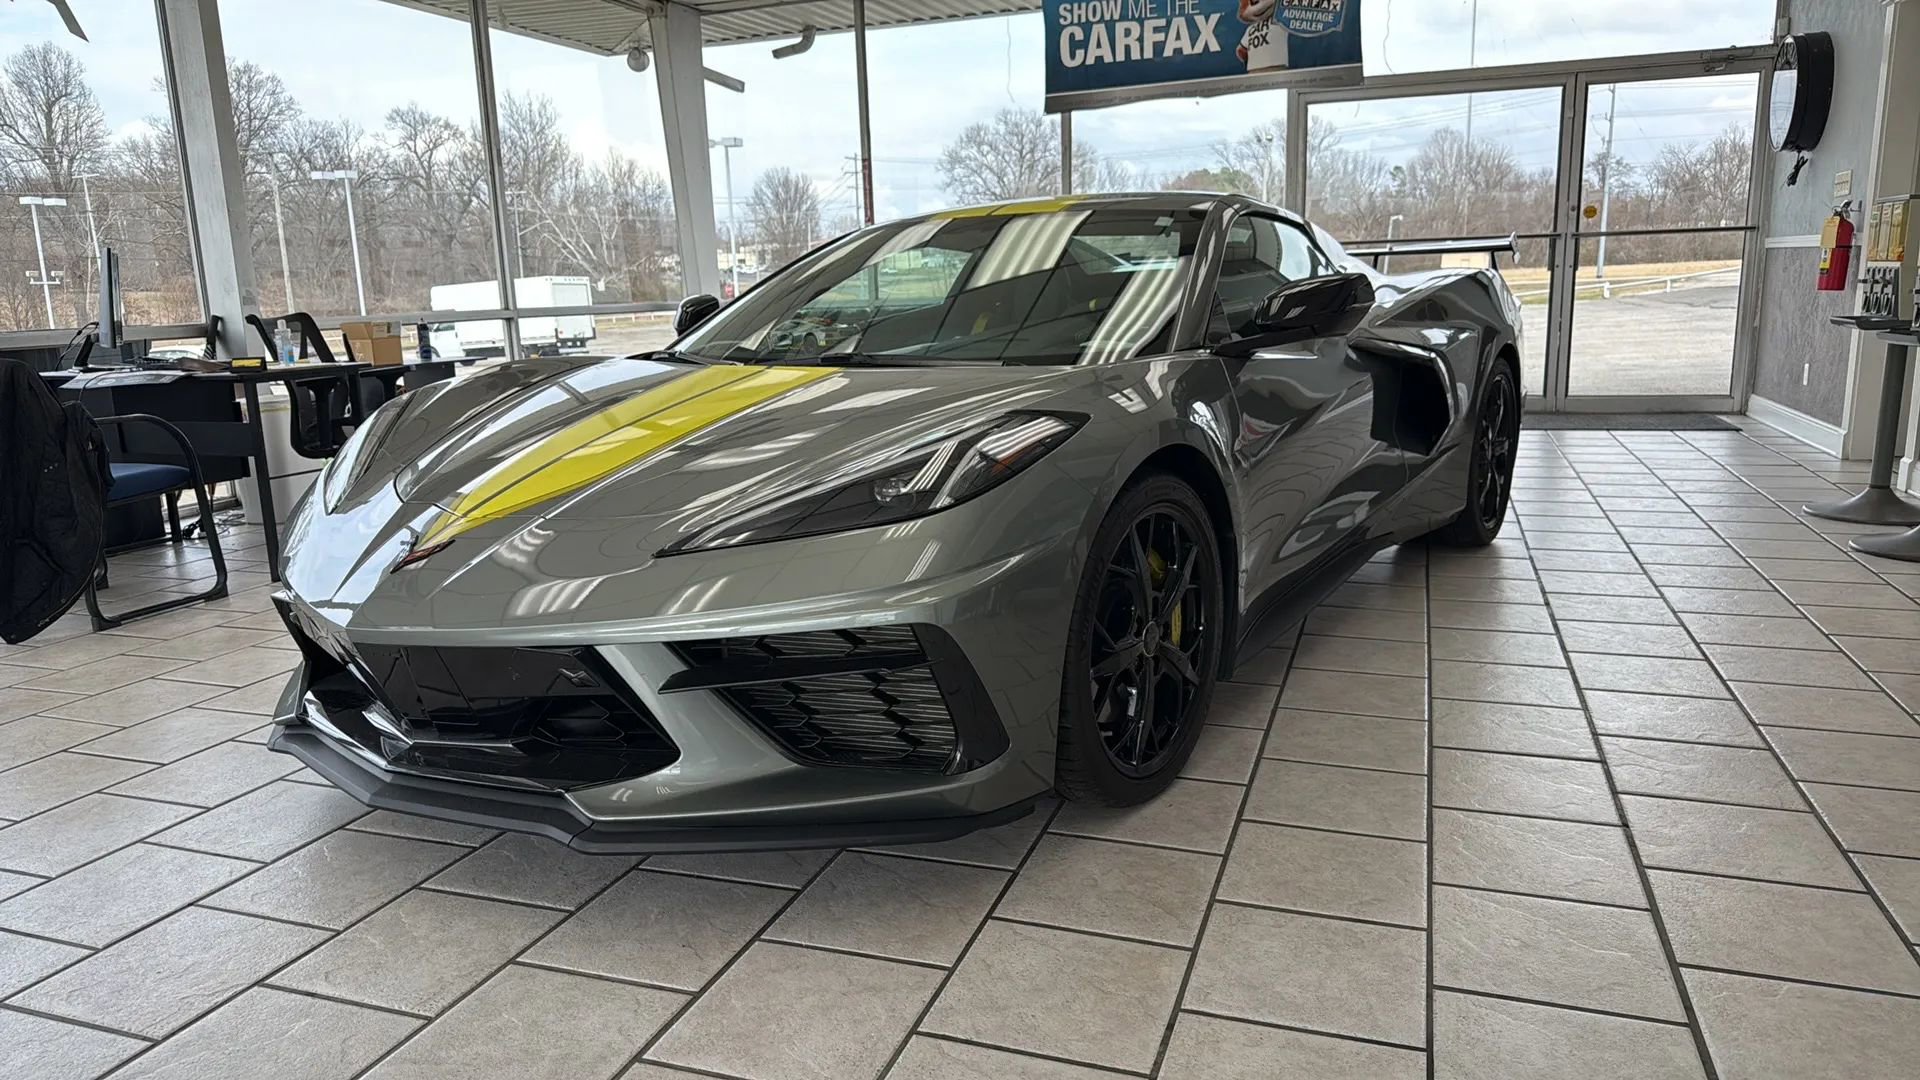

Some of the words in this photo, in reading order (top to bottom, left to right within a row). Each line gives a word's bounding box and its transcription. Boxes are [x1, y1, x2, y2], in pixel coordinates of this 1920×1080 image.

[1059, 0, 1122, 25] SHOW
[1128, 0, 1157, 19] ME
[1164, 0, 1200, 16] THE
[1282, 9, 1334, 22] ADVANTAGE
[1289, 20, 1323, 31] DEALER
[1059, 13, 1221, 68] CARFAX
[1248, 31, 1270, 48] FOX
